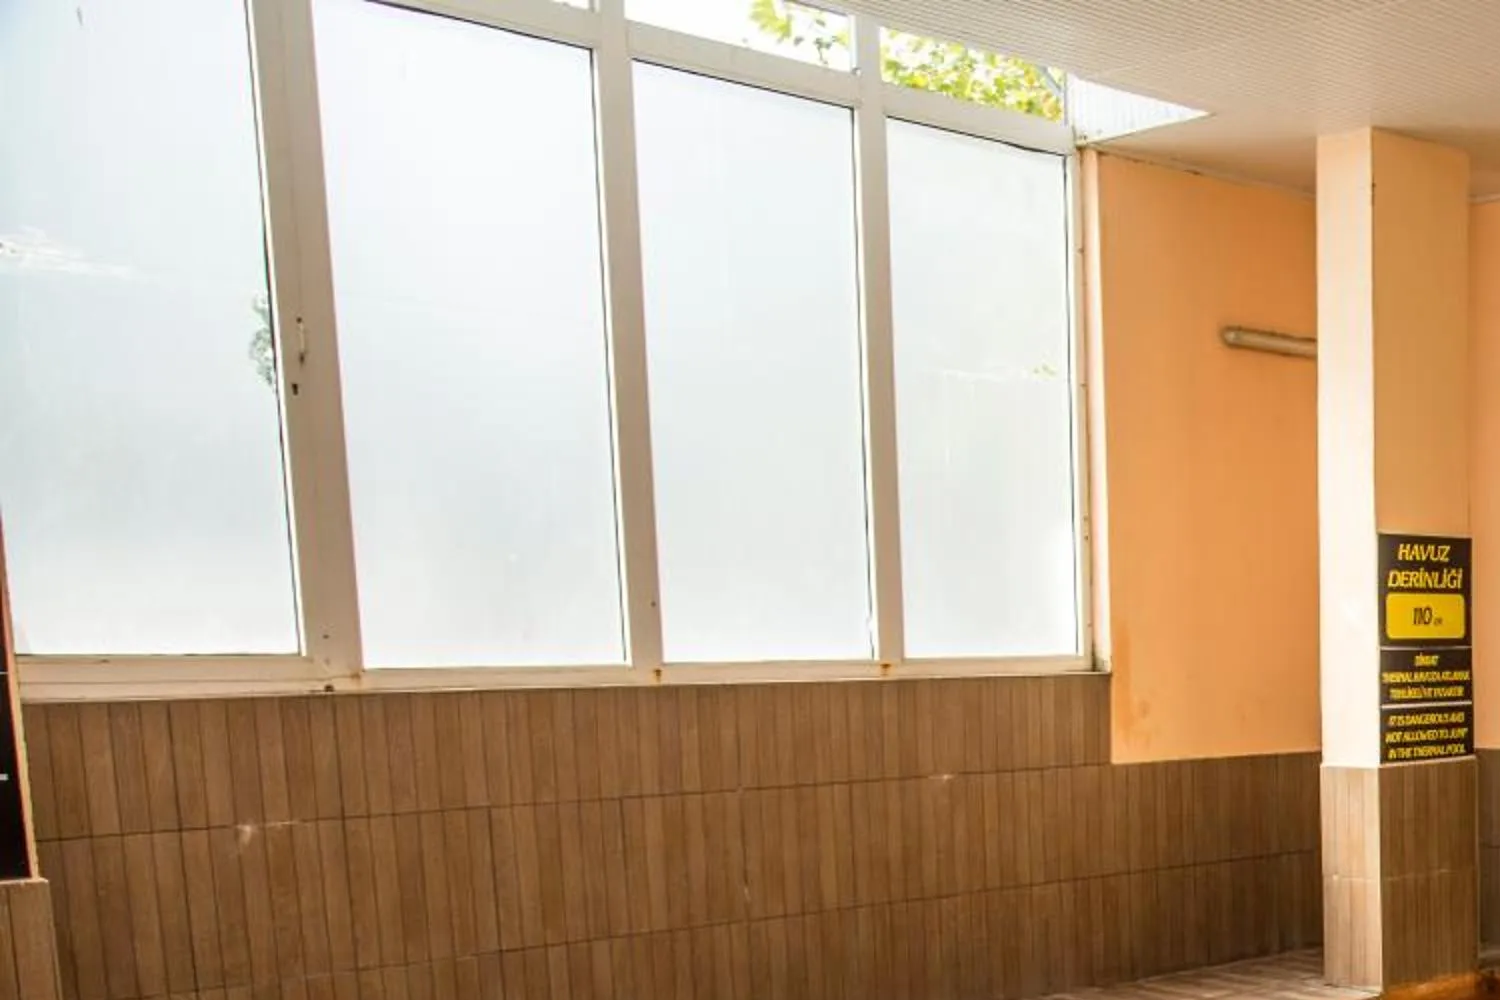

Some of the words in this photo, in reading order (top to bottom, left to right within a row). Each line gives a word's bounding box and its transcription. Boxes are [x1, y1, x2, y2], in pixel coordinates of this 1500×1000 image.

[1398, 543, 1451, 563] HAVUZ
[1387, 567, 1463, 589] DERİNLİĞİ
[1413, 606, 1433, 625] 110
